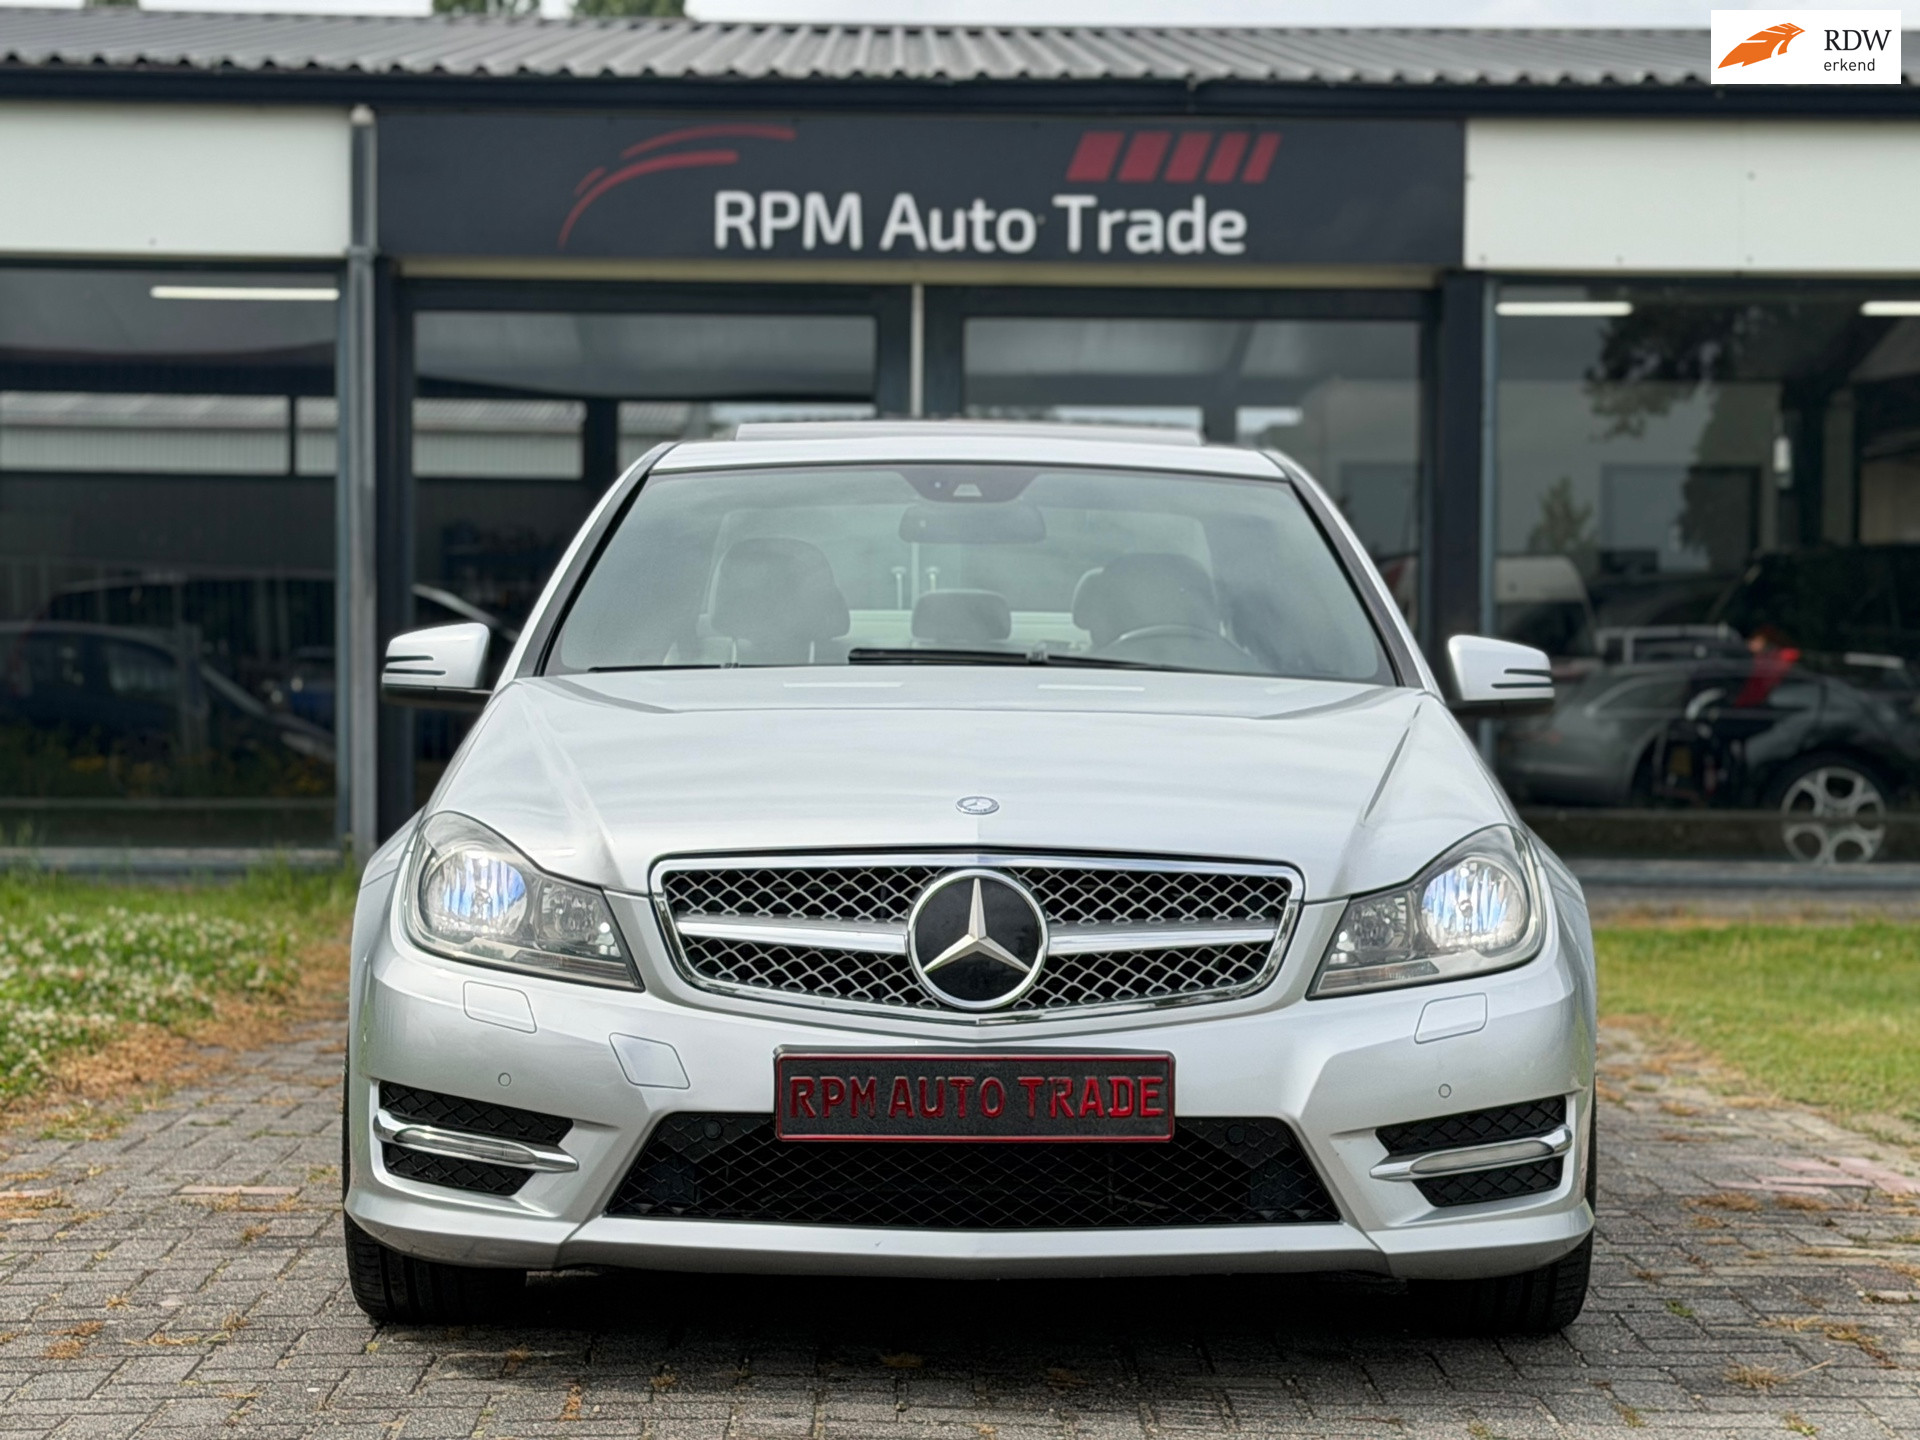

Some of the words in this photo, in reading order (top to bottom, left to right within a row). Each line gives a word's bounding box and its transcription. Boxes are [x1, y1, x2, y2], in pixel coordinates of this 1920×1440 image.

[714, 191, 863, 250] RPM
[879, 193, 1038, 253] Auto
[1052, 195, 1247, 254] Trade
[789, 1075, 877, 1119] RPM
[888, 1075, 1006, 1119] AUTO
[1017, 1076, 1164, 1119] TRADE
